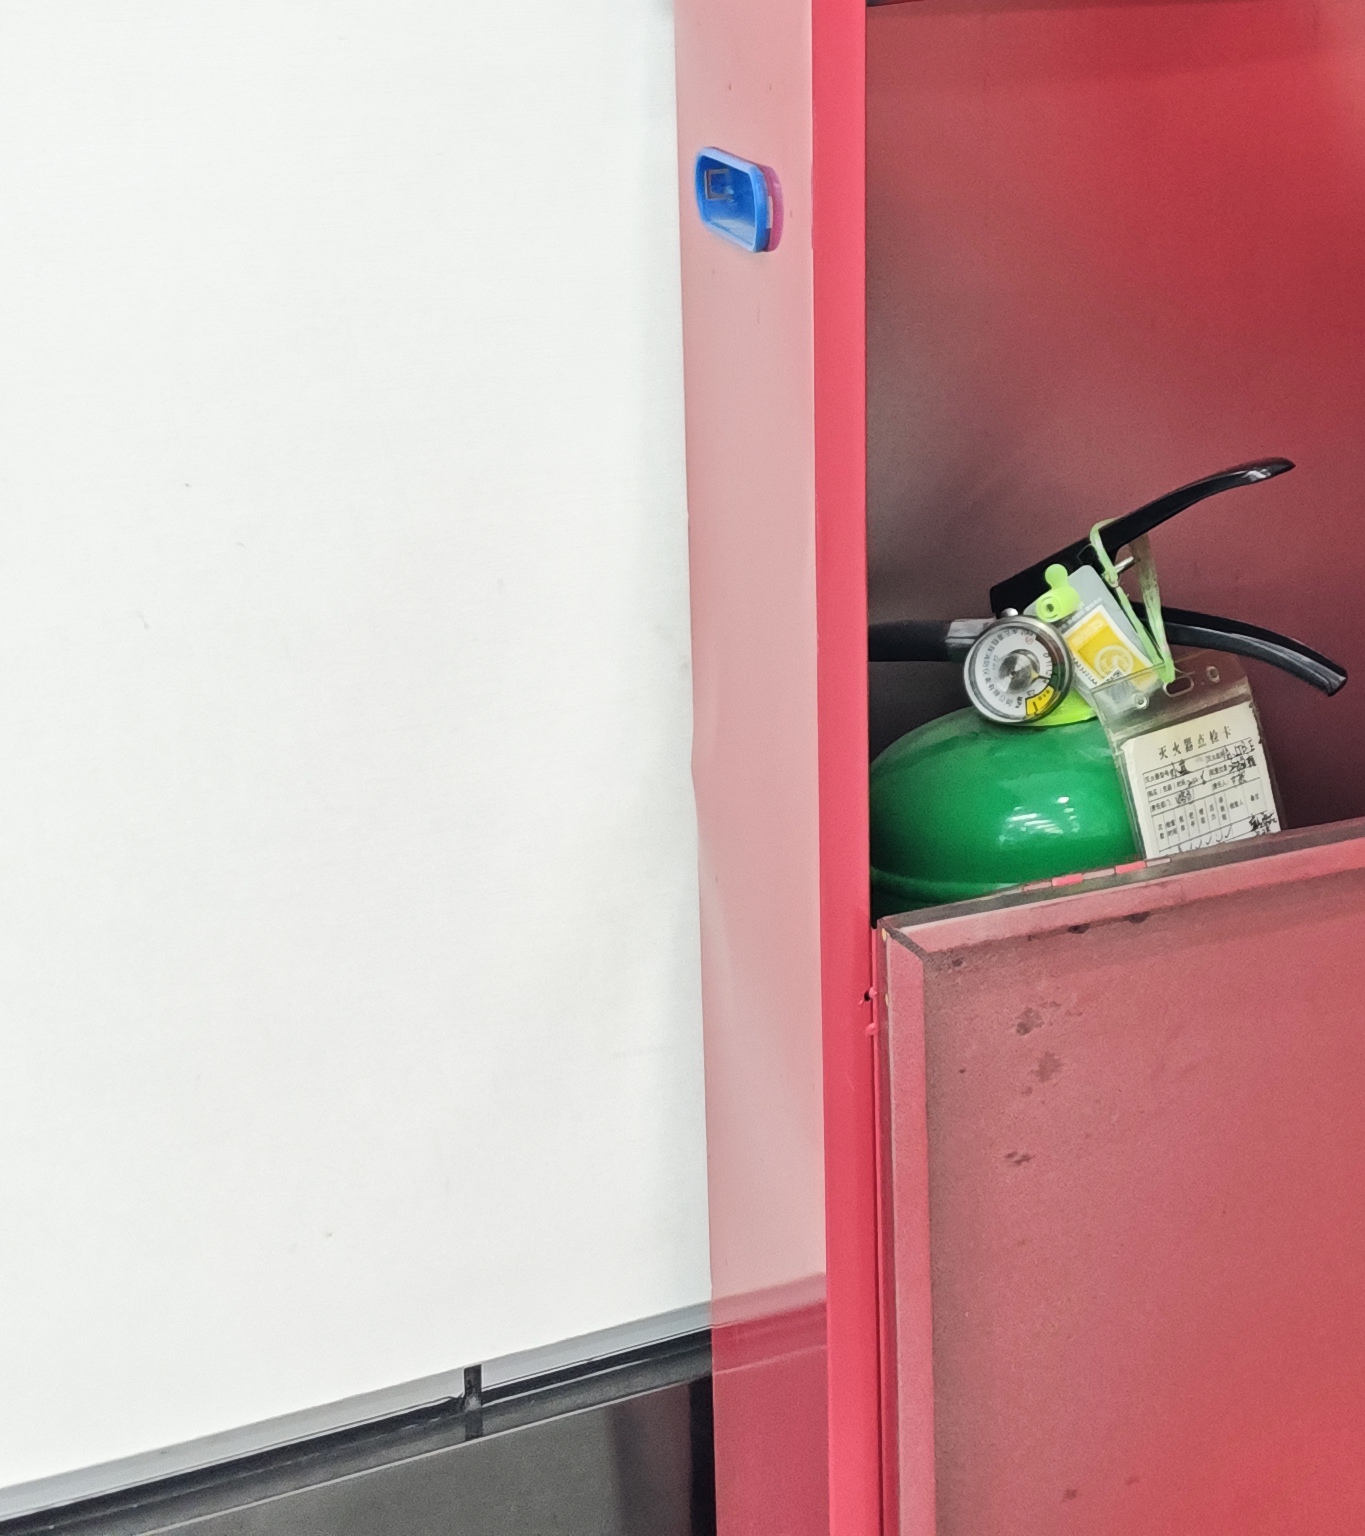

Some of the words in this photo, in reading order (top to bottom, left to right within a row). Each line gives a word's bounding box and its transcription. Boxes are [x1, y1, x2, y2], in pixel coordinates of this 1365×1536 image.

[1156, 725, 1231, 760] 灭火器点检卡
